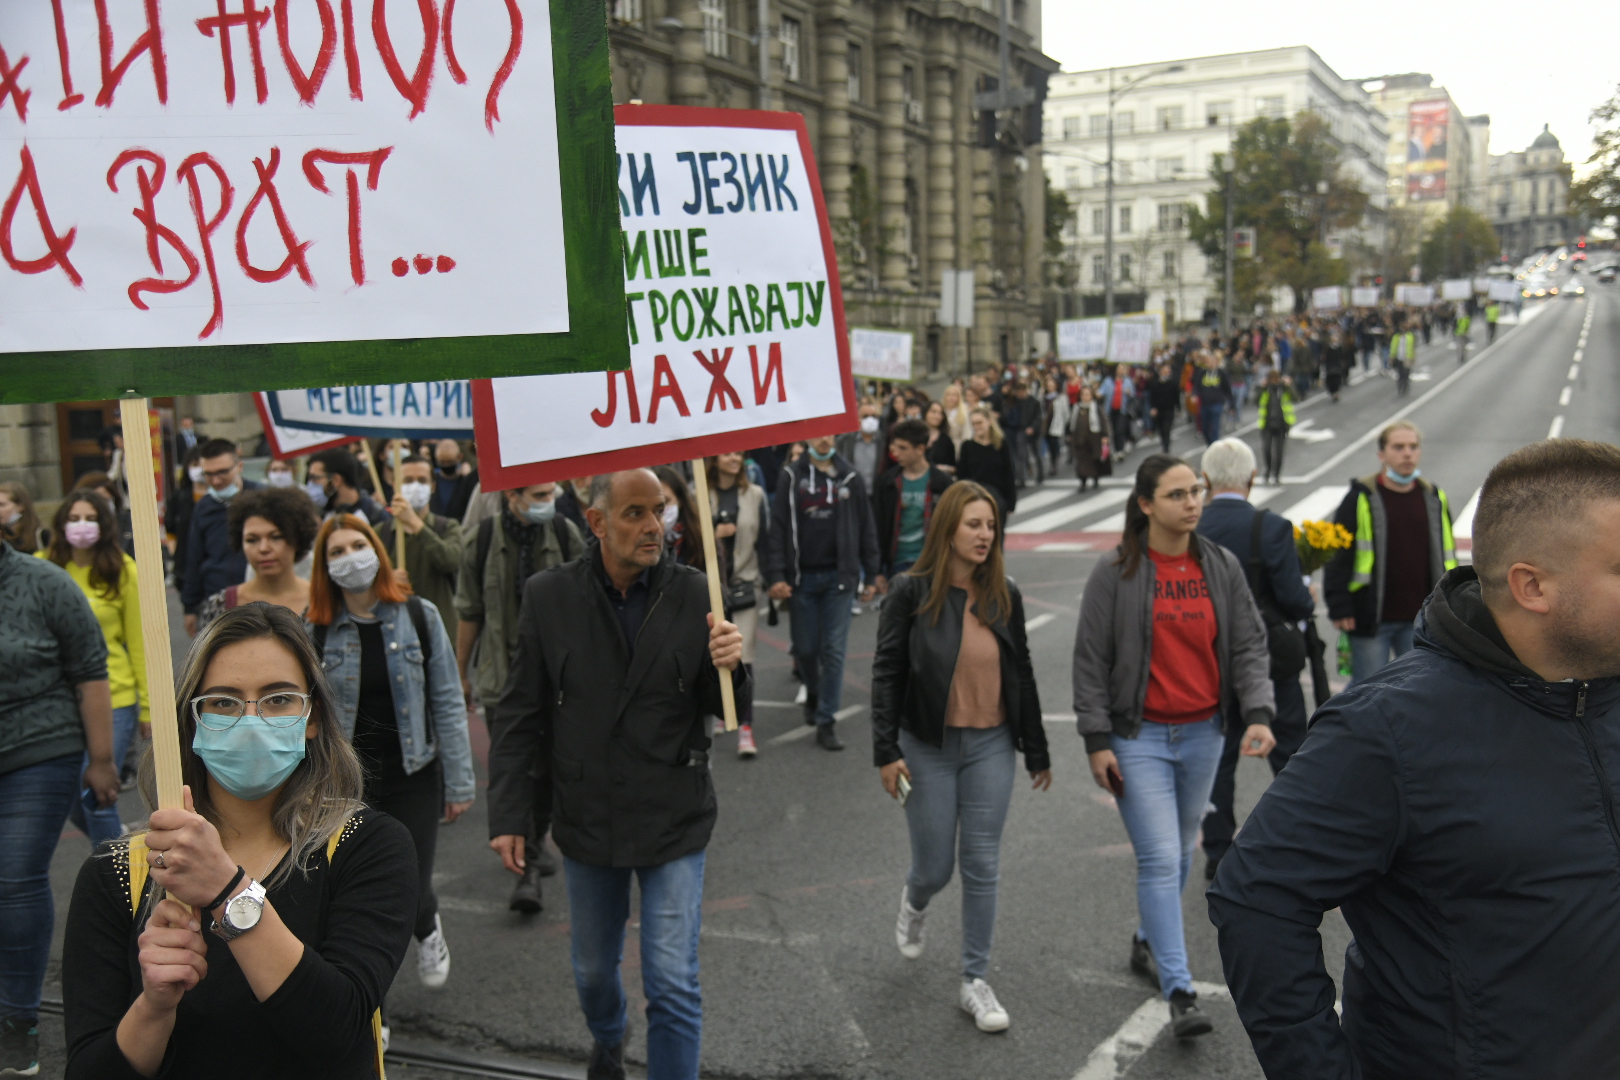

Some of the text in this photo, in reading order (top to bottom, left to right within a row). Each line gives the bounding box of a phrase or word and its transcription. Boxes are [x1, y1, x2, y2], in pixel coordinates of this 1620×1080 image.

[677, 152, 799, 216] ЈЕЗИК
[628, 280, 826, 345] ГРОЖАВАЈУ
[590, 342, 788, 428] ЛАЖИ
